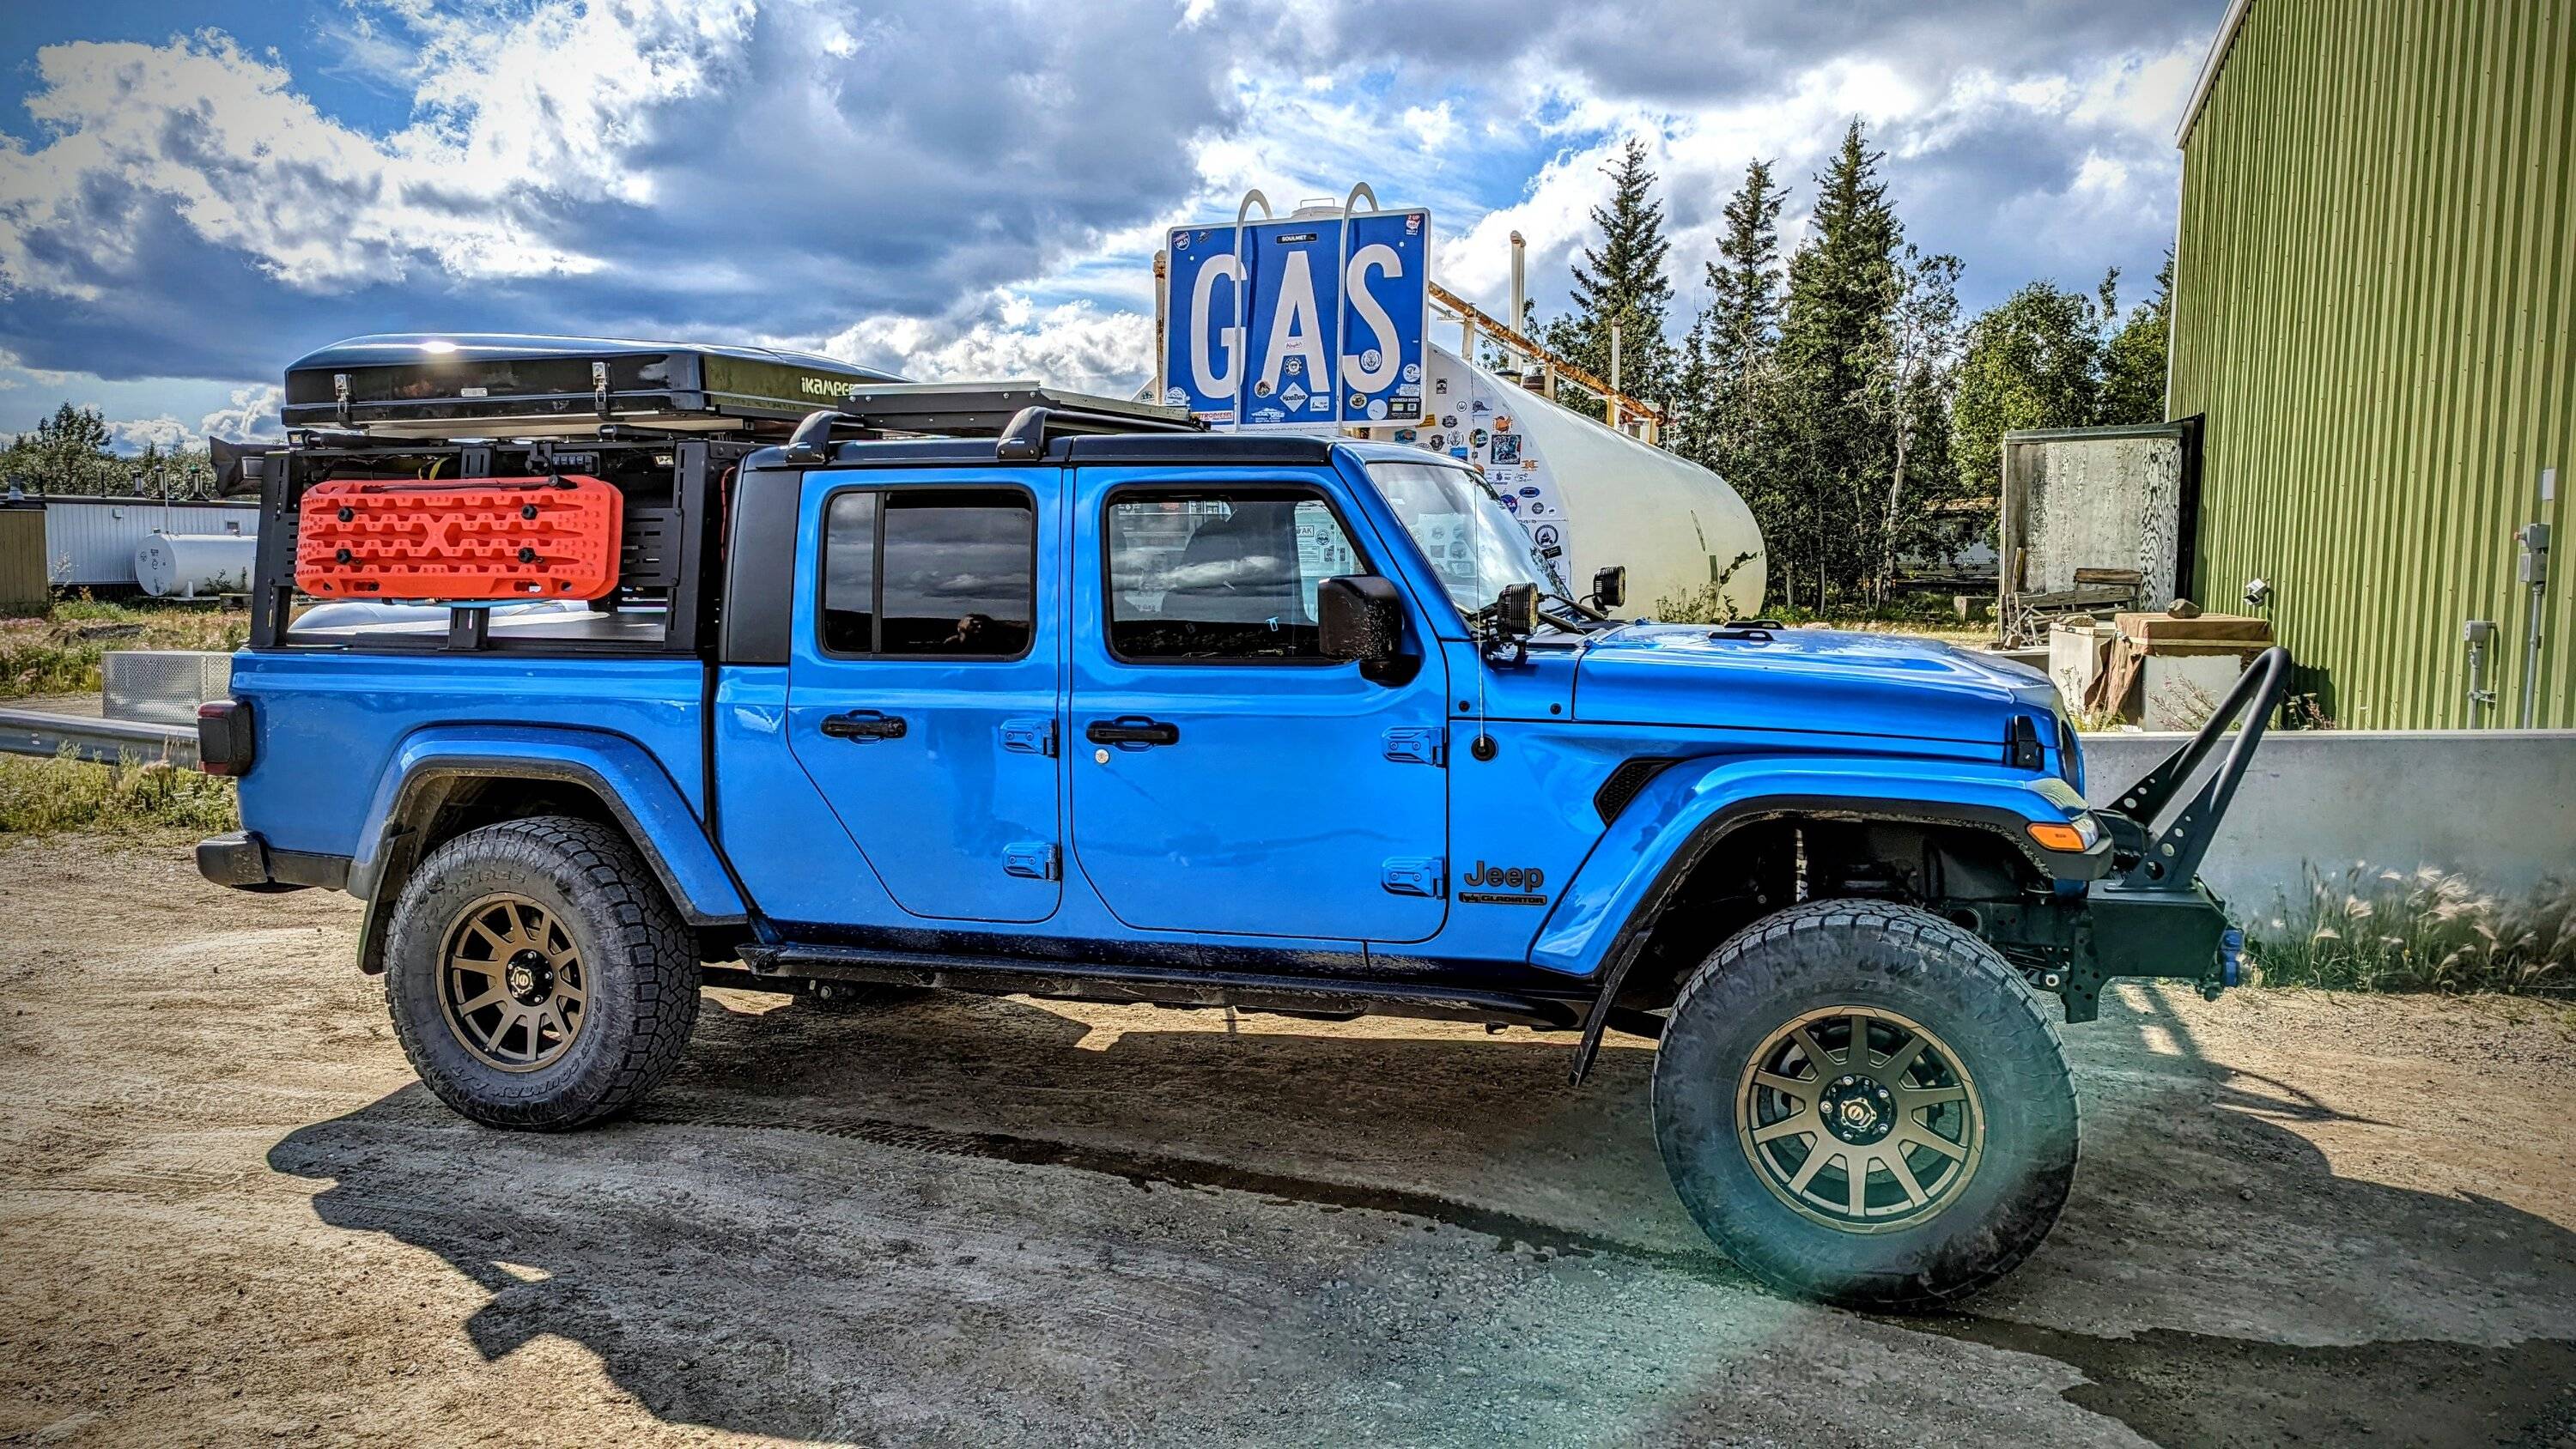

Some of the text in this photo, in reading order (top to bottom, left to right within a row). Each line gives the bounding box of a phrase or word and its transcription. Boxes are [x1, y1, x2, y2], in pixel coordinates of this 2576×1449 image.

[1190, 243, 1403, 399] GAS
[1463, 860, 1545, 893] Jeep
[1481, 894, 1545, 904] GLADIATOR
